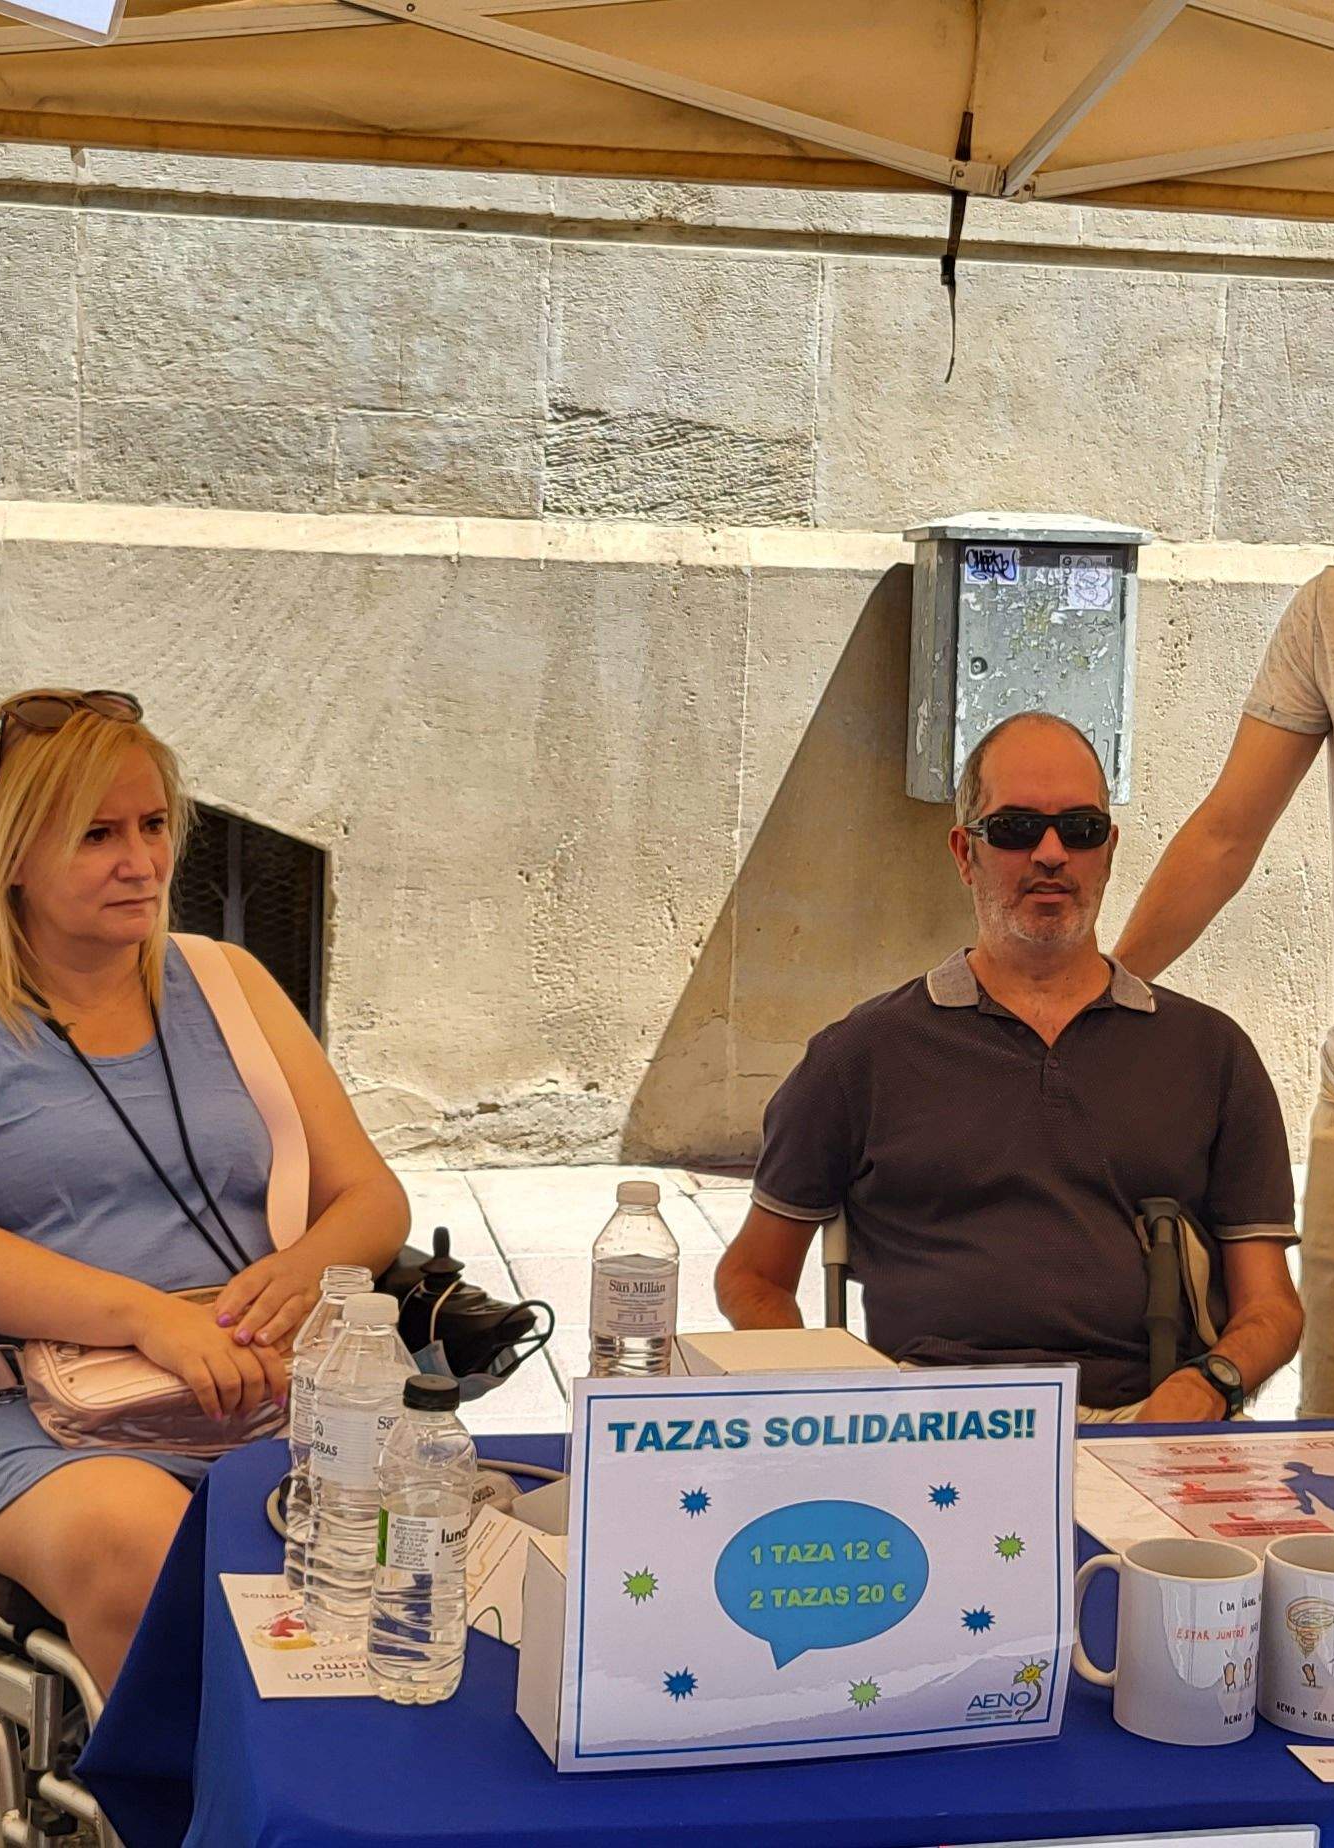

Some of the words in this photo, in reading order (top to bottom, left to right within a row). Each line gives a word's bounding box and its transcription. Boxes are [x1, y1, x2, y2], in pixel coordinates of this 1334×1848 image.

[609, 1280, 630, 1293] San
[633, 1281, 666, 1294] Millán
[377, 1416, 394, 1430] Sa
[607, 1418, 749, 1453] TAZAS
[763, 1409, 1037, 1447] SOLIDARIAS!!
[750, 1545, 762, 1565] 1
[770, 1543, 835, 1564] TAZA
[842, 1541, 871, 1560] 12
[876, 1540, 892, 1559] €
[749, 1589, 764, 1609] 2
[770, 1586, 850, 1607] TAZAS
[856, 1584, 885, 1604] 20
[891, 1582, 907, 1602] €
[1176, 1630, 1210, 1640] ESTAR
[1216, 1626, 1245, 1640] JUNTOS
[312, 1661, 367, 1671] ismo
[287, 1671, 366, 1681] ciación
[967, 1690, 1032, 1710] AENO
[1276, 1702, 1296, 1716] AENO
[1223, 1712, 1243, 1726] AENO
